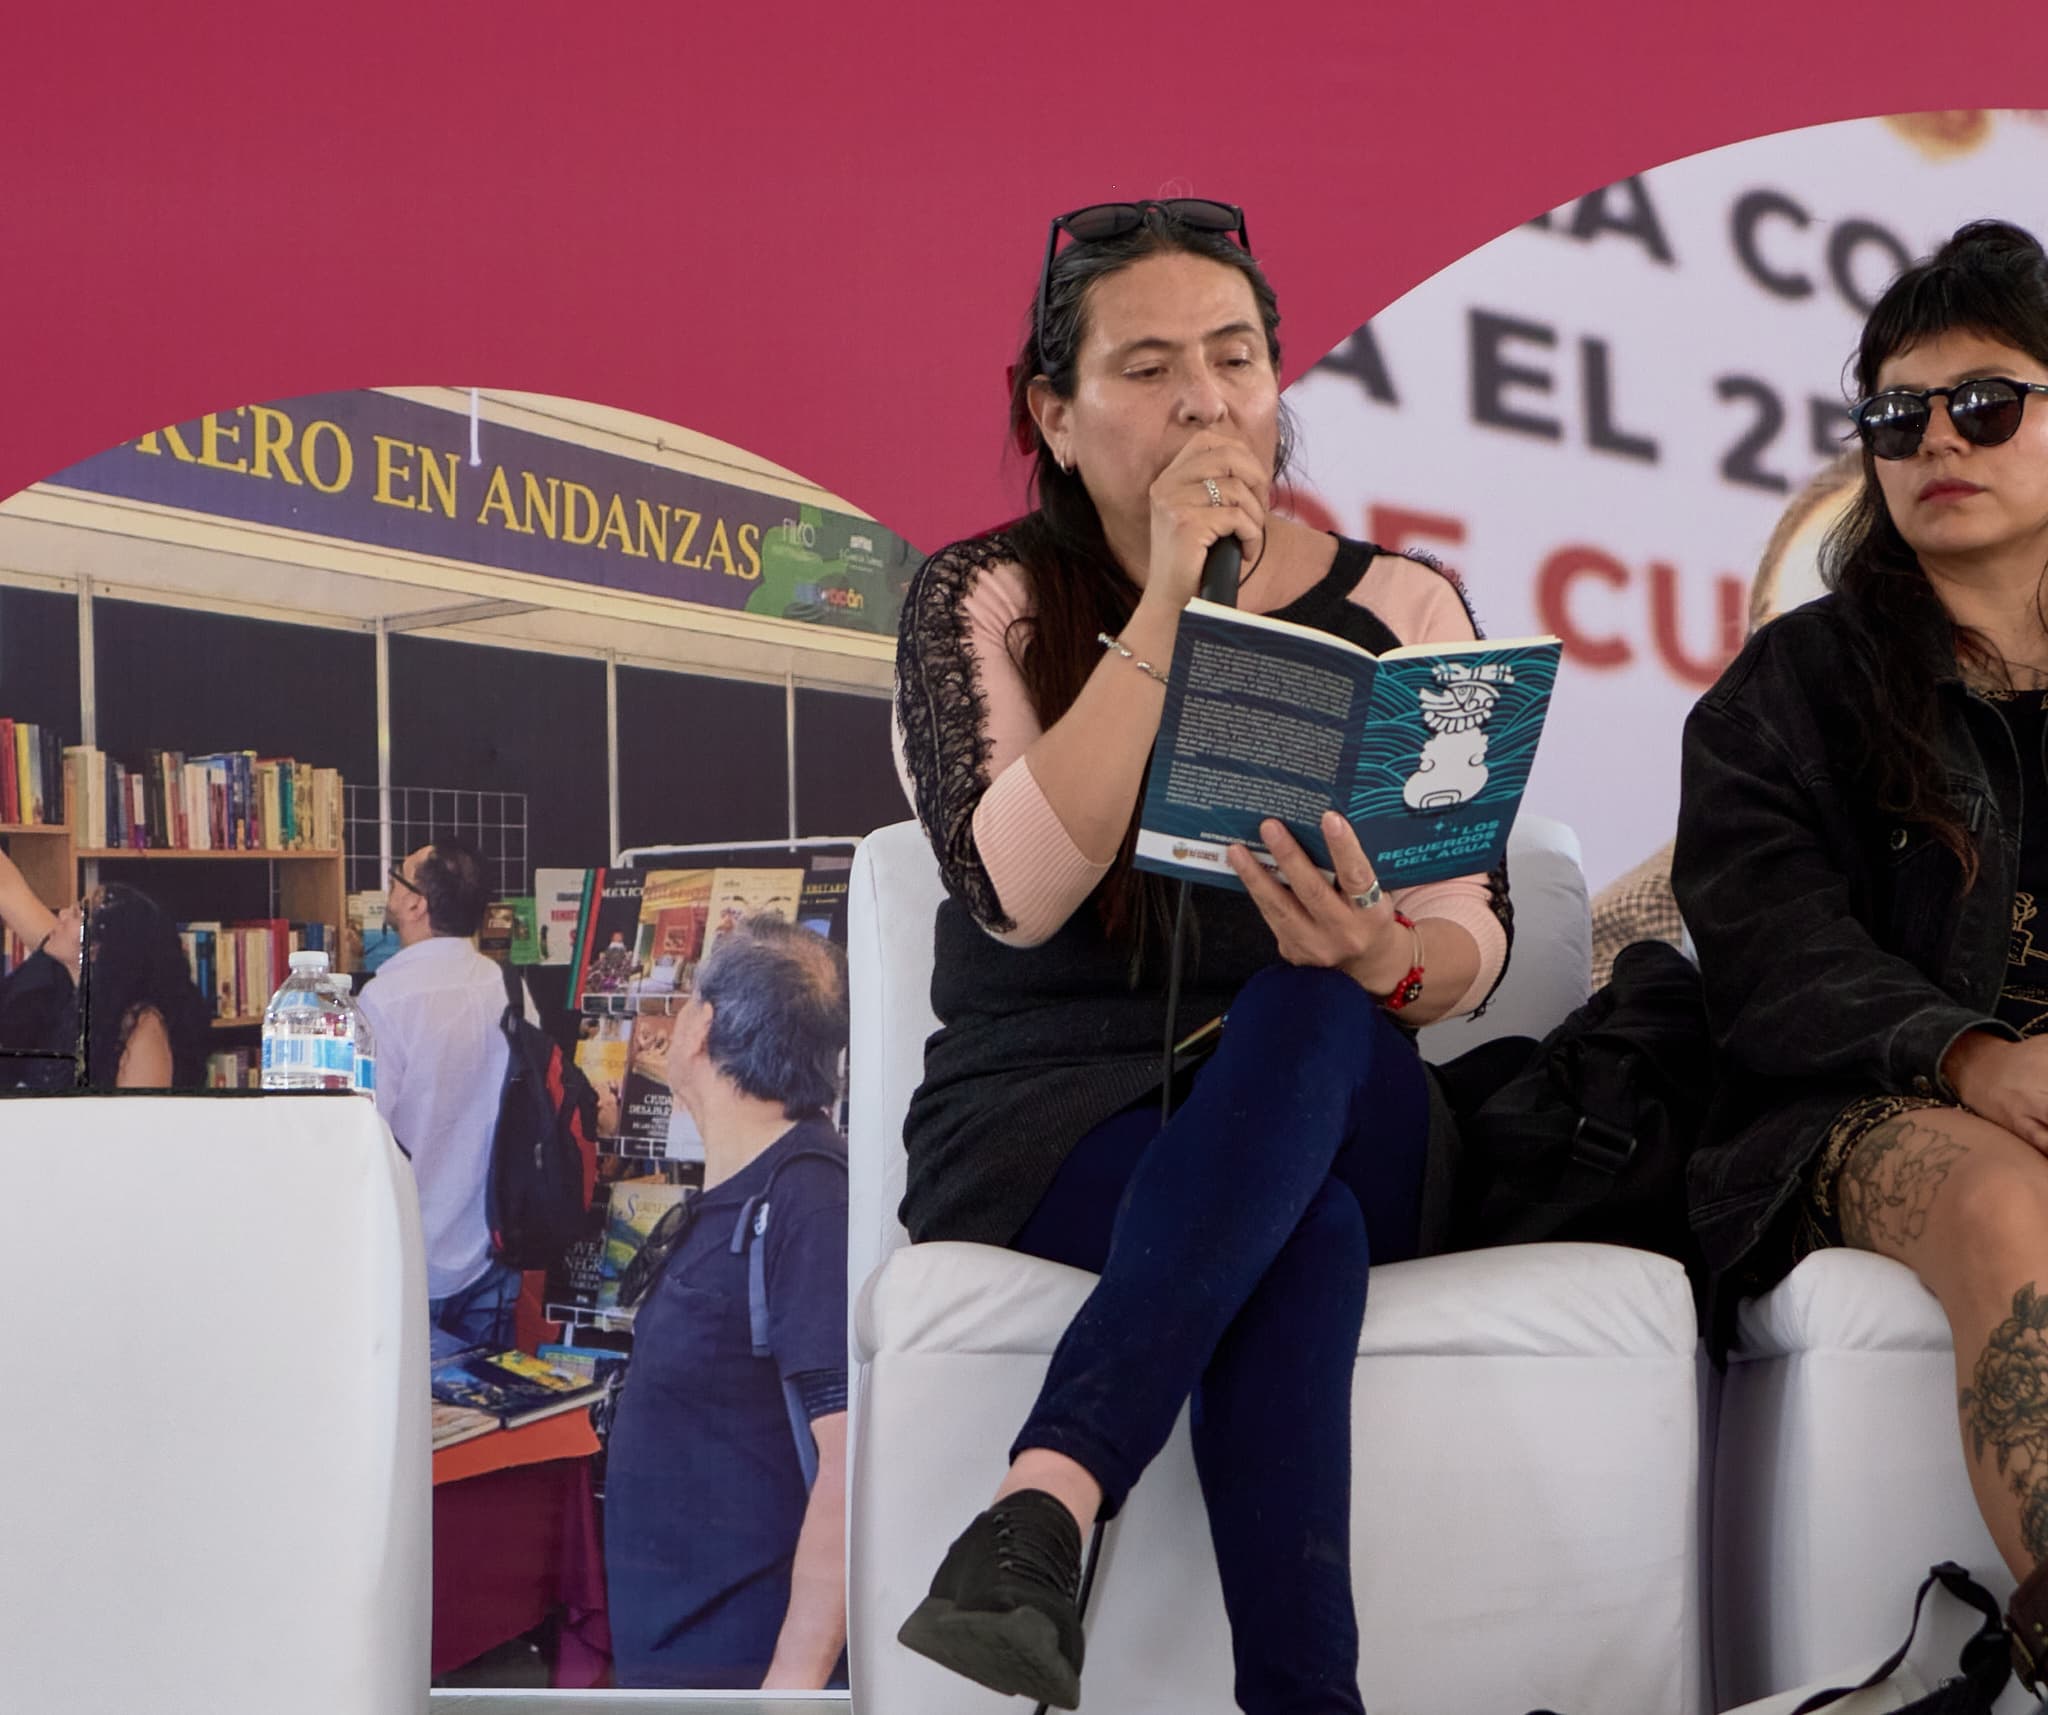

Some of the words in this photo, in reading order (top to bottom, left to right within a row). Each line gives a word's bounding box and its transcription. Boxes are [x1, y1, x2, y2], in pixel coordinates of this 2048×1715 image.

[1466, 305, 1662, 466] EL
[372, 435, 461, 519] EN
[477, 466, 762, 581] ANDANZAS
[1462, 820, 1499, 835] LOS
[1377, 830, 1496, 862] RECUERDOS
[1394, 854, 1432, 869] DEL
[1435, 841, 1491, 859] AGUA
